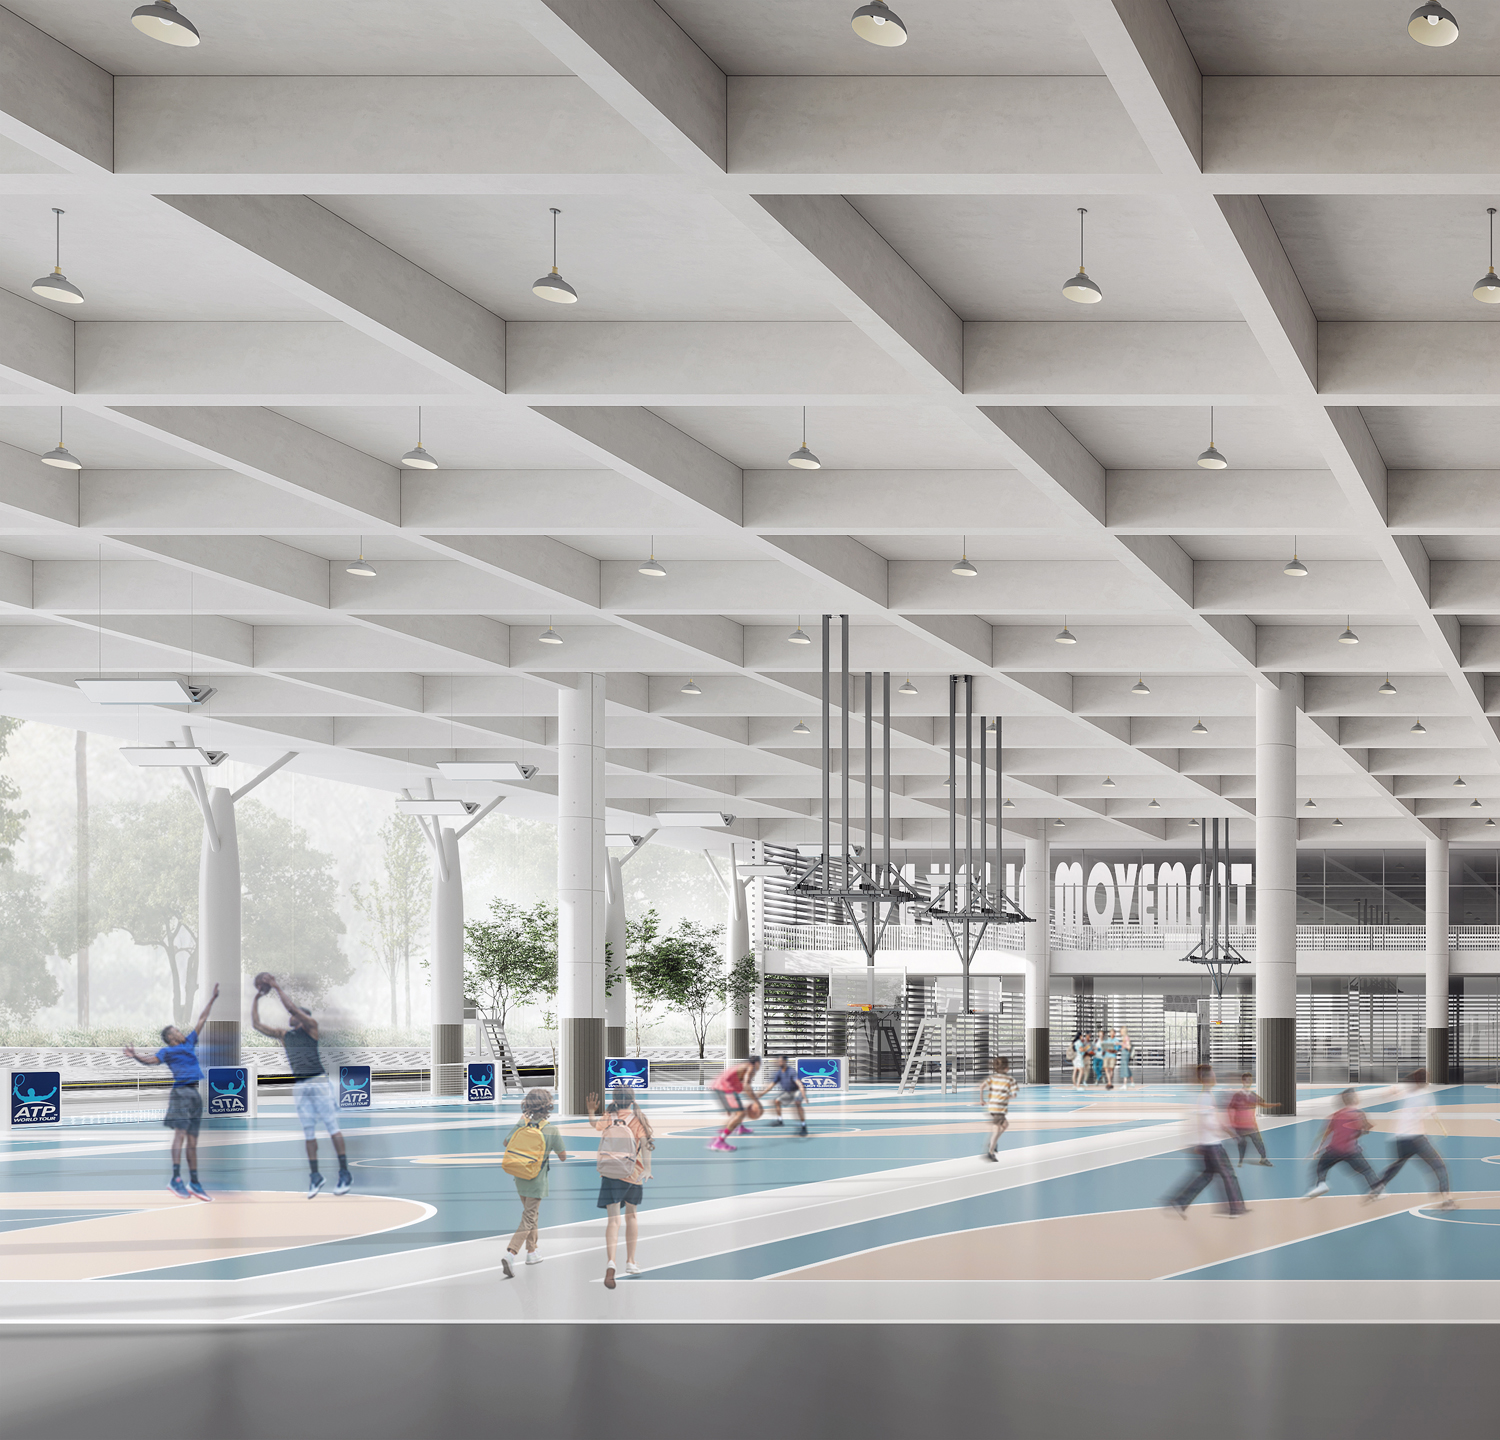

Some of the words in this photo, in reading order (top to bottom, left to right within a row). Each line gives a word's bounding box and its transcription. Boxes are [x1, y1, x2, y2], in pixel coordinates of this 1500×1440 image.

[1054, 861, 1253, 930] MOVEMENT
[341, 1093, 369, 1103] ATP
[14, 1106, 56, 1118] ATP
